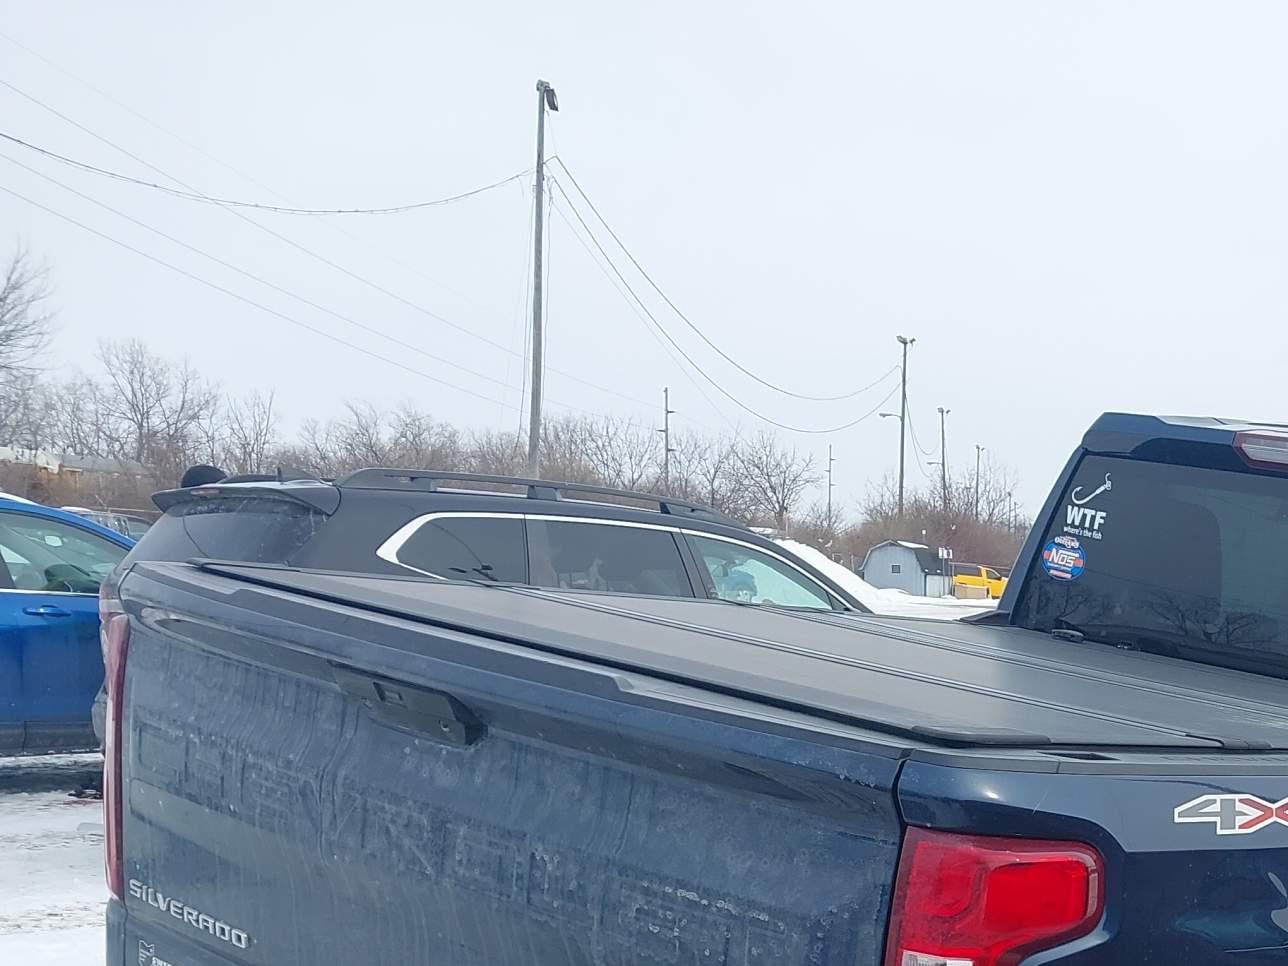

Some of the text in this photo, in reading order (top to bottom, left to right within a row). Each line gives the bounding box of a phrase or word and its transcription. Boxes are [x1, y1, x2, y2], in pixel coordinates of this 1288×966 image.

[1066, 504, 1107, 530] WTF
[1048, 547, 1077, 568] NOS
[129, 878, 250, 950] SILVERADO
